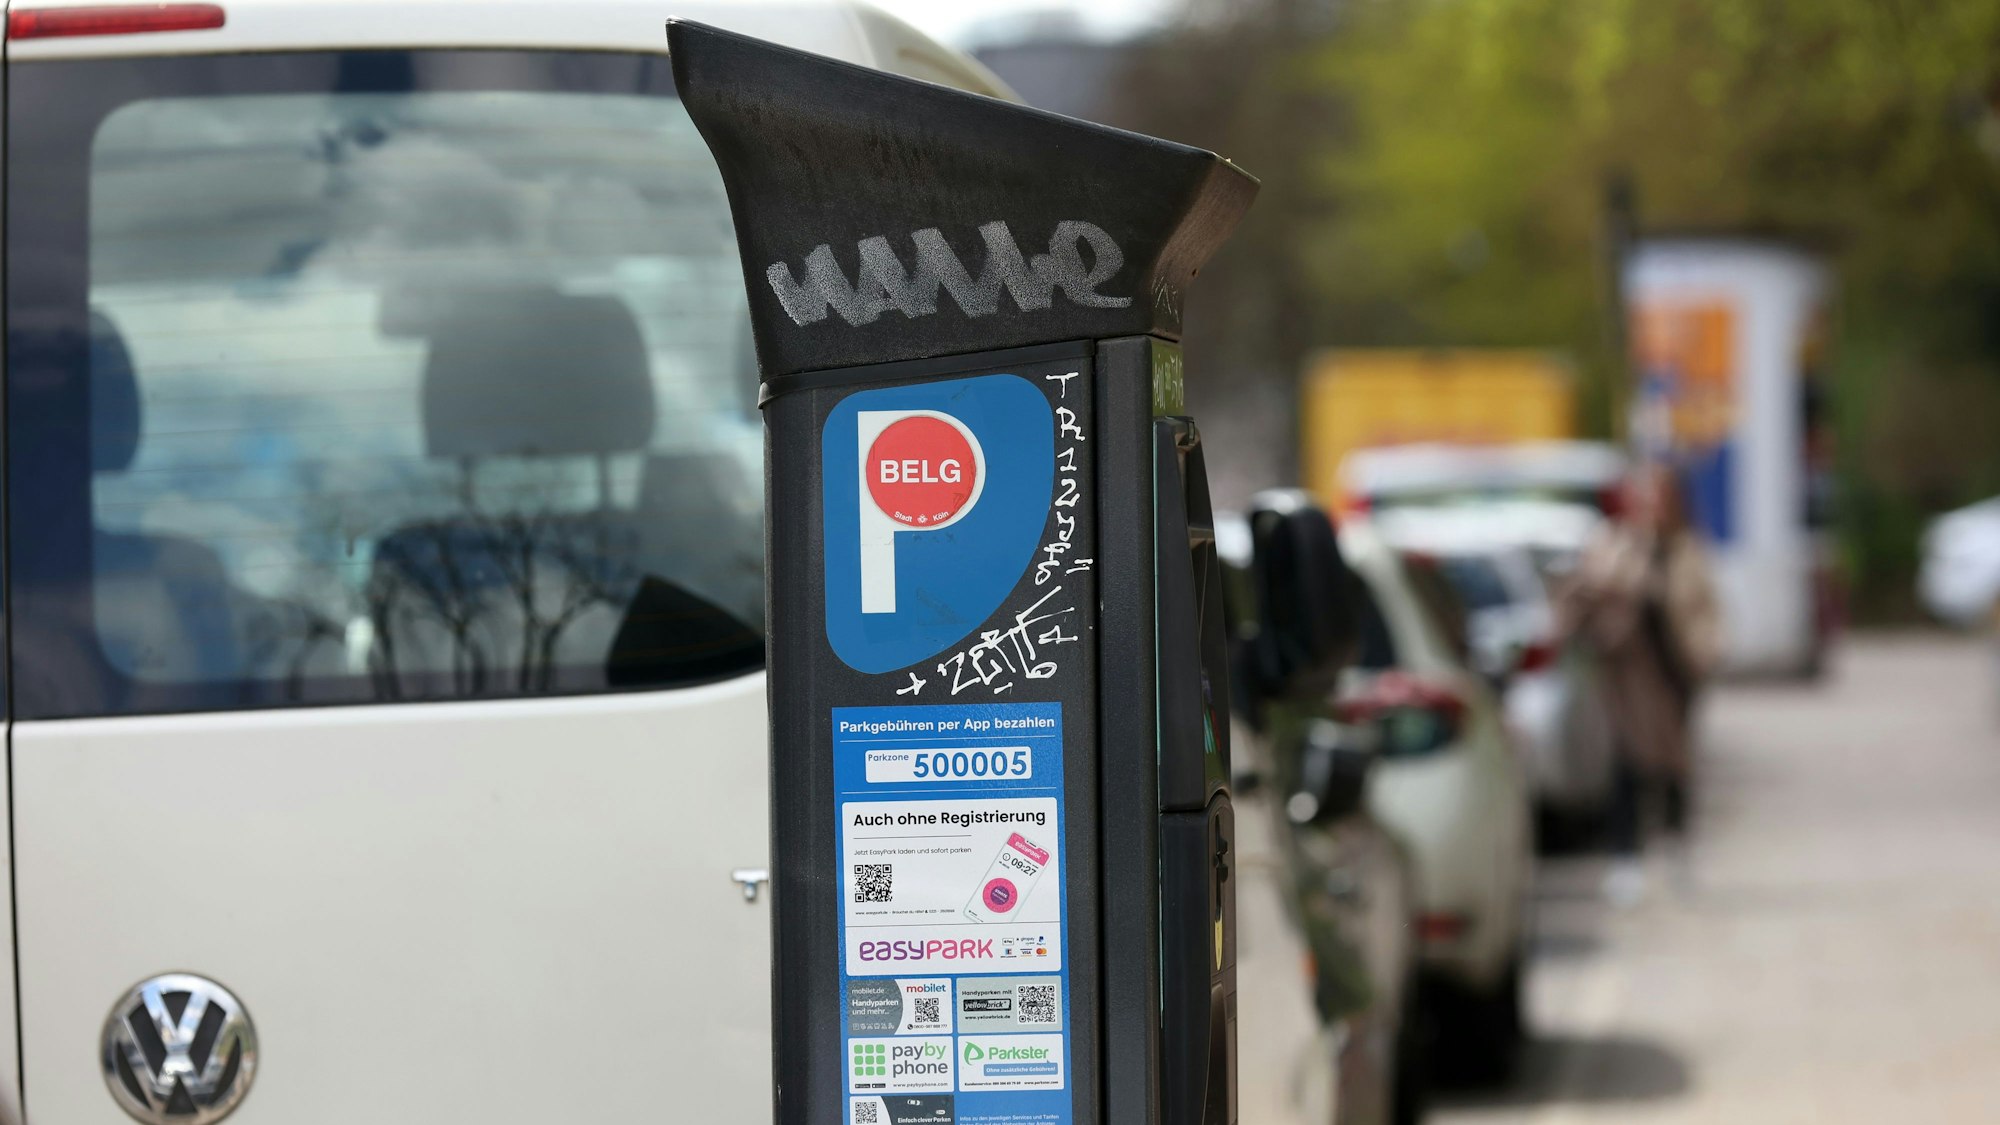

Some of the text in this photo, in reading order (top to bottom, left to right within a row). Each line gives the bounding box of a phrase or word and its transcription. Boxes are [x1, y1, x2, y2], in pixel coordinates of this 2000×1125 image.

[880, 459, 961, 484] BELG
[894, 511, 949, 522] Stadt Köln
[840, 716, 1055, 735] Parkgebühren per App bezahlen
[868, 751, 1027, 778] Parkzone 500005
[854, 810, 1046, 828] Auch ohne Registrierung
[869, 848, 896, 857] EasyPark
[930, 847, 949, 855] sofort
[949, 847, 972, 855] parken
[1011, 857, 1037, 877] 09:27
[851, 987, 885, 995] mobilet.de
[906, 983, 947, 993] mobilet
[852, 998, 899, 1008] Handyparken
[964, 1000, 1004, 1010] yellowbrick
[852, 1008, 866, 1016] und
[892, 1041, 947, 1060] payby
[988, 1046, 1049, 1060] Parkster
[892, 1060, 948, 1078] phone
[986, 1066, 1000, 1074] Ohne
[917, 1116, 933, 1124] clever
